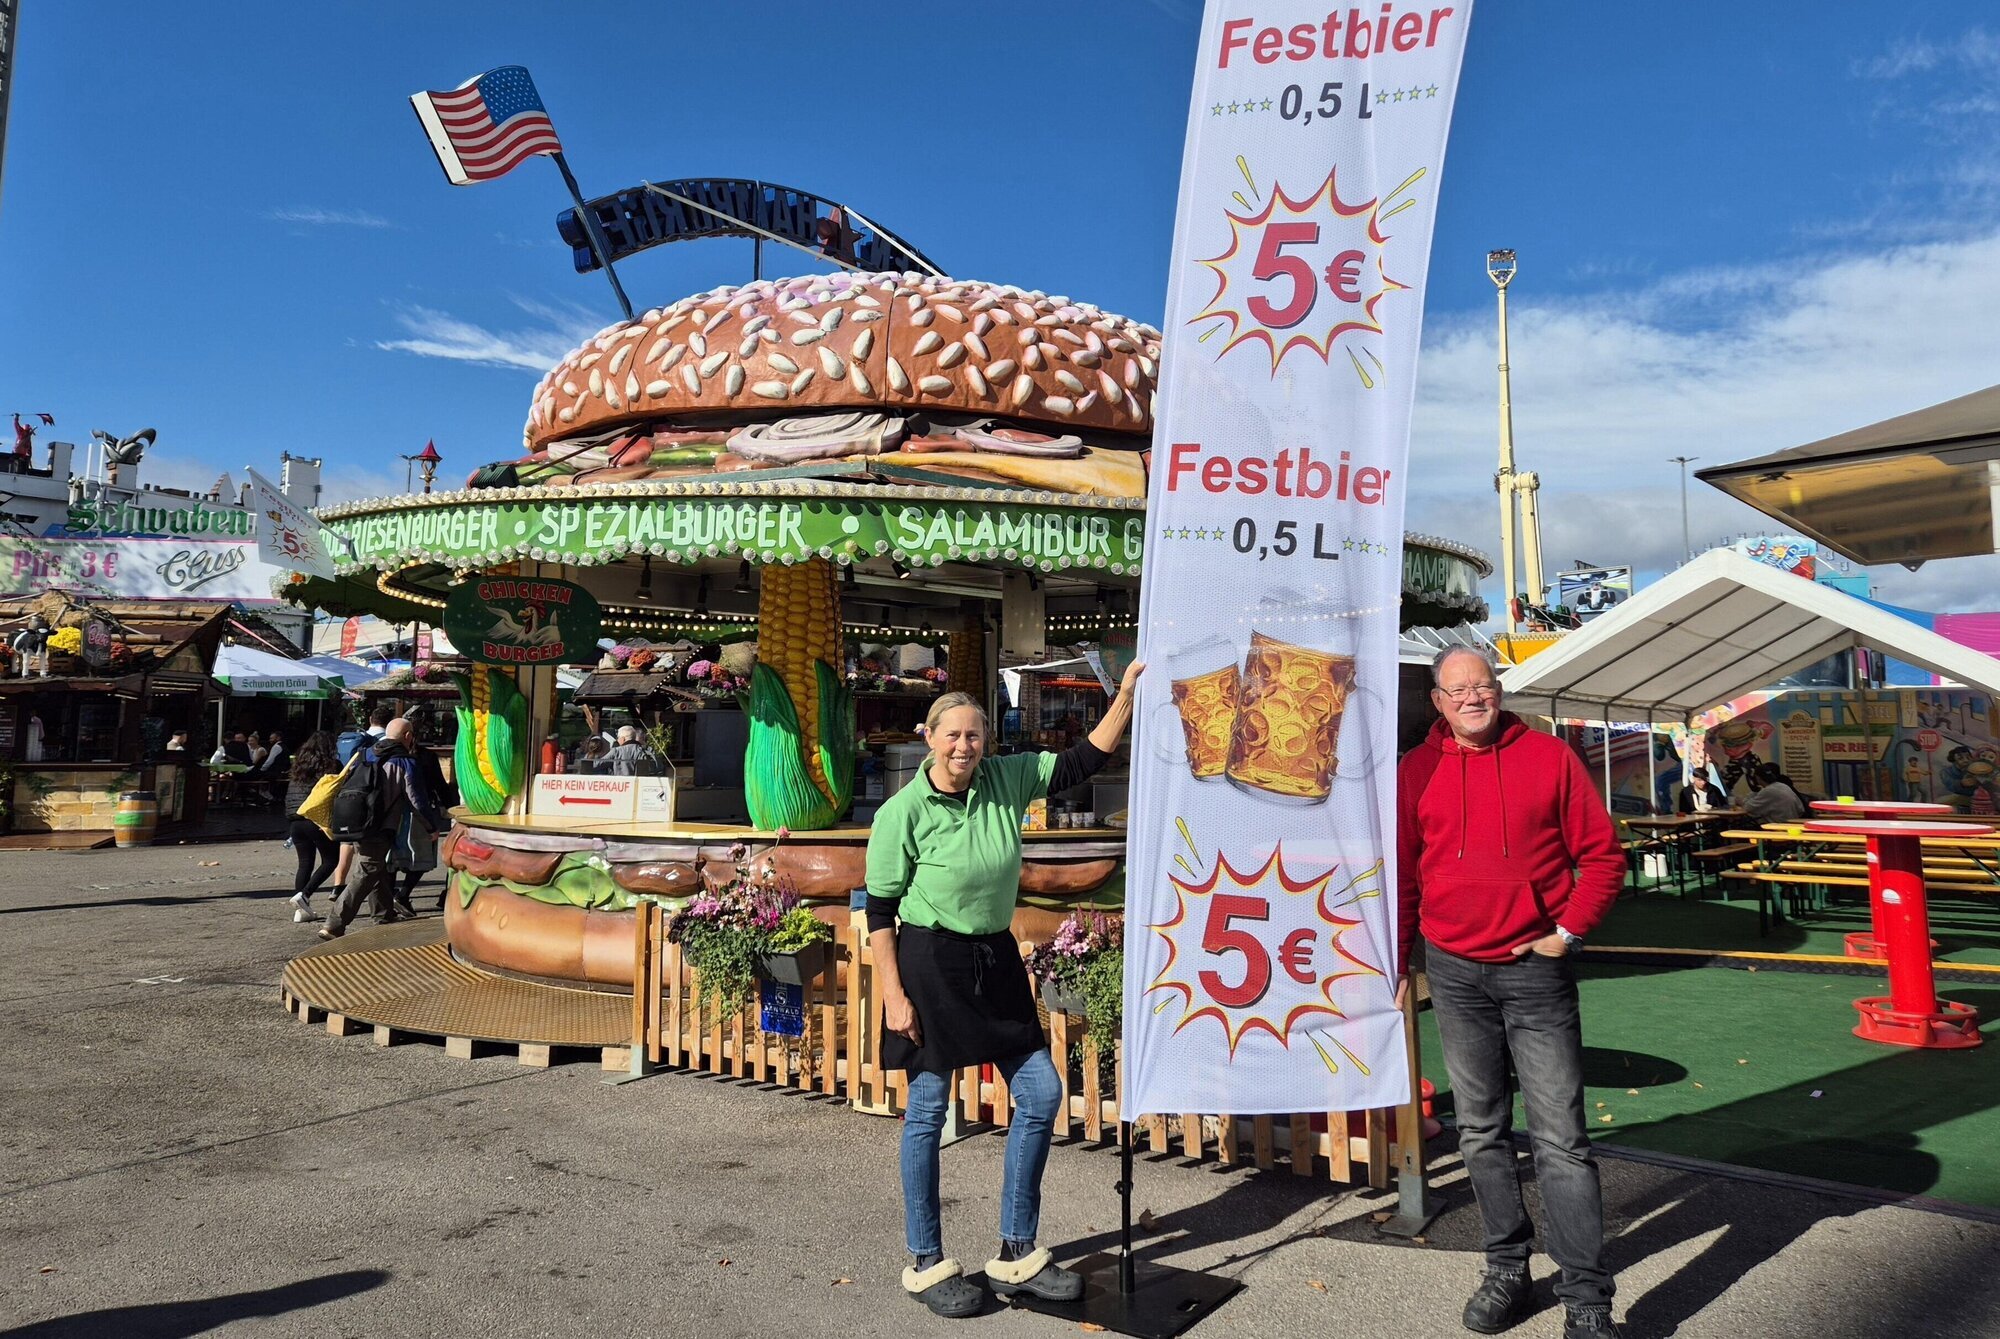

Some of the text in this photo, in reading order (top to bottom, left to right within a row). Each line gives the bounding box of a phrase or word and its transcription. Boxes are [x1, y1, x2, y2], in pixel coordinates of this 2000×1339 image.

[1217, 2, 1454, 68] Festbier
[1279, 82, 1343, 126] 0,5
[1247, 221, 1366, 330] 5€
[1167, 442, 1392, 507] Festbier
[64, 499, 250, 536] Schwaben
[352, 507, 499, 560] RIESENBURGER
[538, 502, 807, 549] SPEZIALBURGER
[1232, 516, 1339, 561] 0,5 L
[12, 550, 62, 577] Pils
[155, 545, 247, 591] Cluss
[478, 580, 573, 605] CHICKEN
[483, 640, 565, 662] BURGER
[241, 678, 307, 689] Schwaben Bräu
[1824, 742, 1879, 753] DER RIEE
[1919, 733, 1937, 746] STOP
[542, 780, 630, 793] HIER KEIN VERKAUF
[1198, 893, 1317, 1009] 5€
